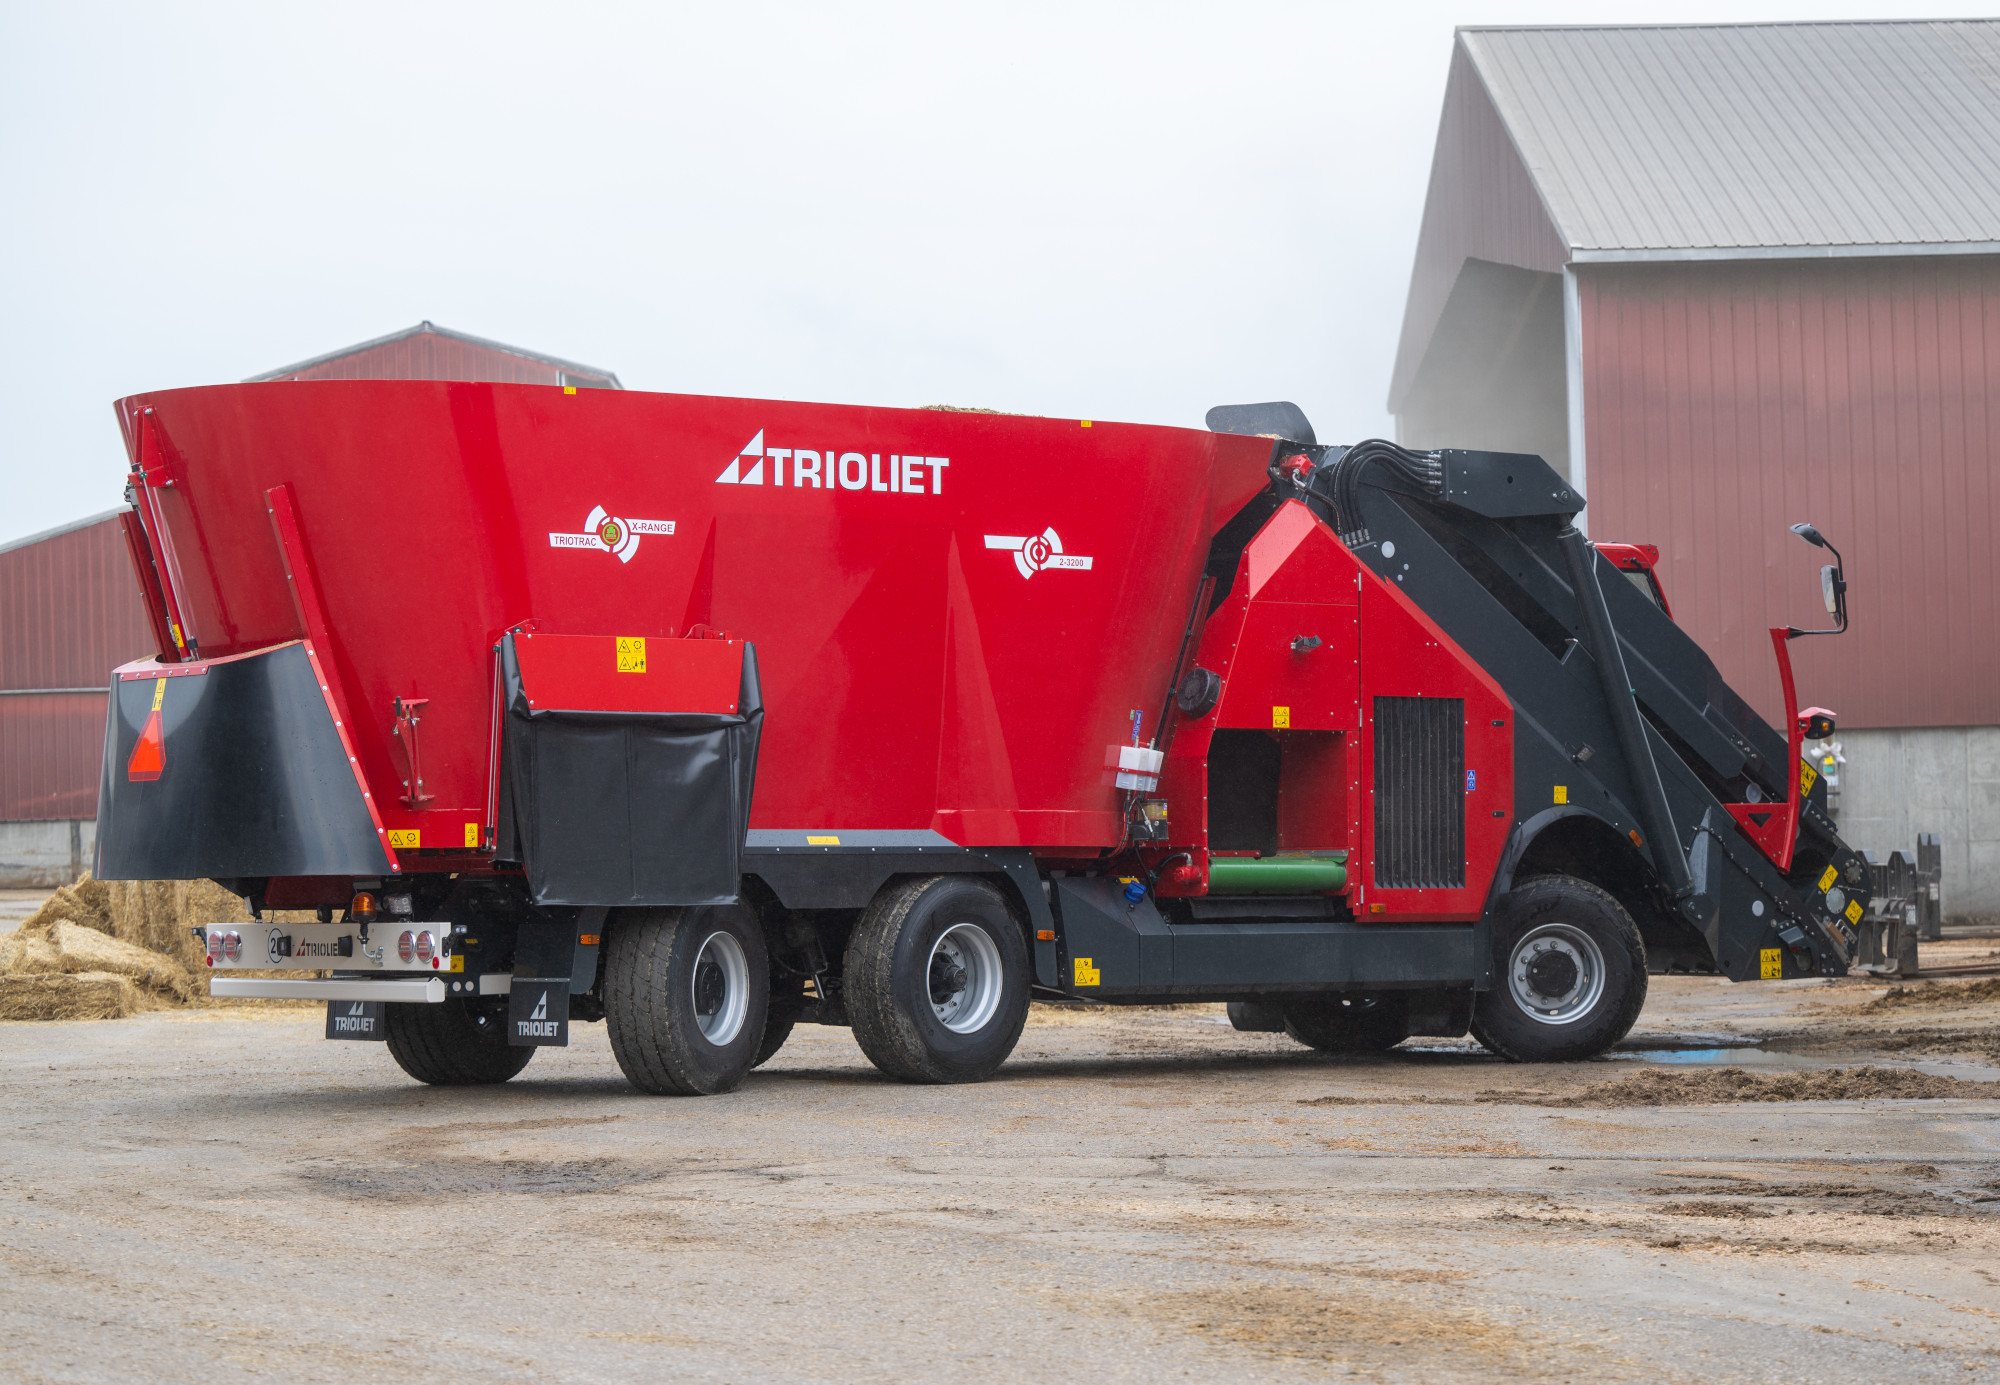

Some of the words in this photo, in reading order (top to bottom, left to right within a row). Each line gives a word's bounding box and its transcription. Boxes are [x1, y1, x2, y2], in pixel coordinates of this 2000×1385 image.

[766, 447, 950, 495] TRIOLIET
[632, 522, 673, 533] X-RANGE
[554, 536, 597, 547] TRIOTRAC
[1059, 558, 1084, 567] 2-3200
[306, 942, 339, 957] TRIOLIE
[334, 1016, 375, 1032] TRIOLIET
[517, 1021, 559, 1037] TRIOLIET
